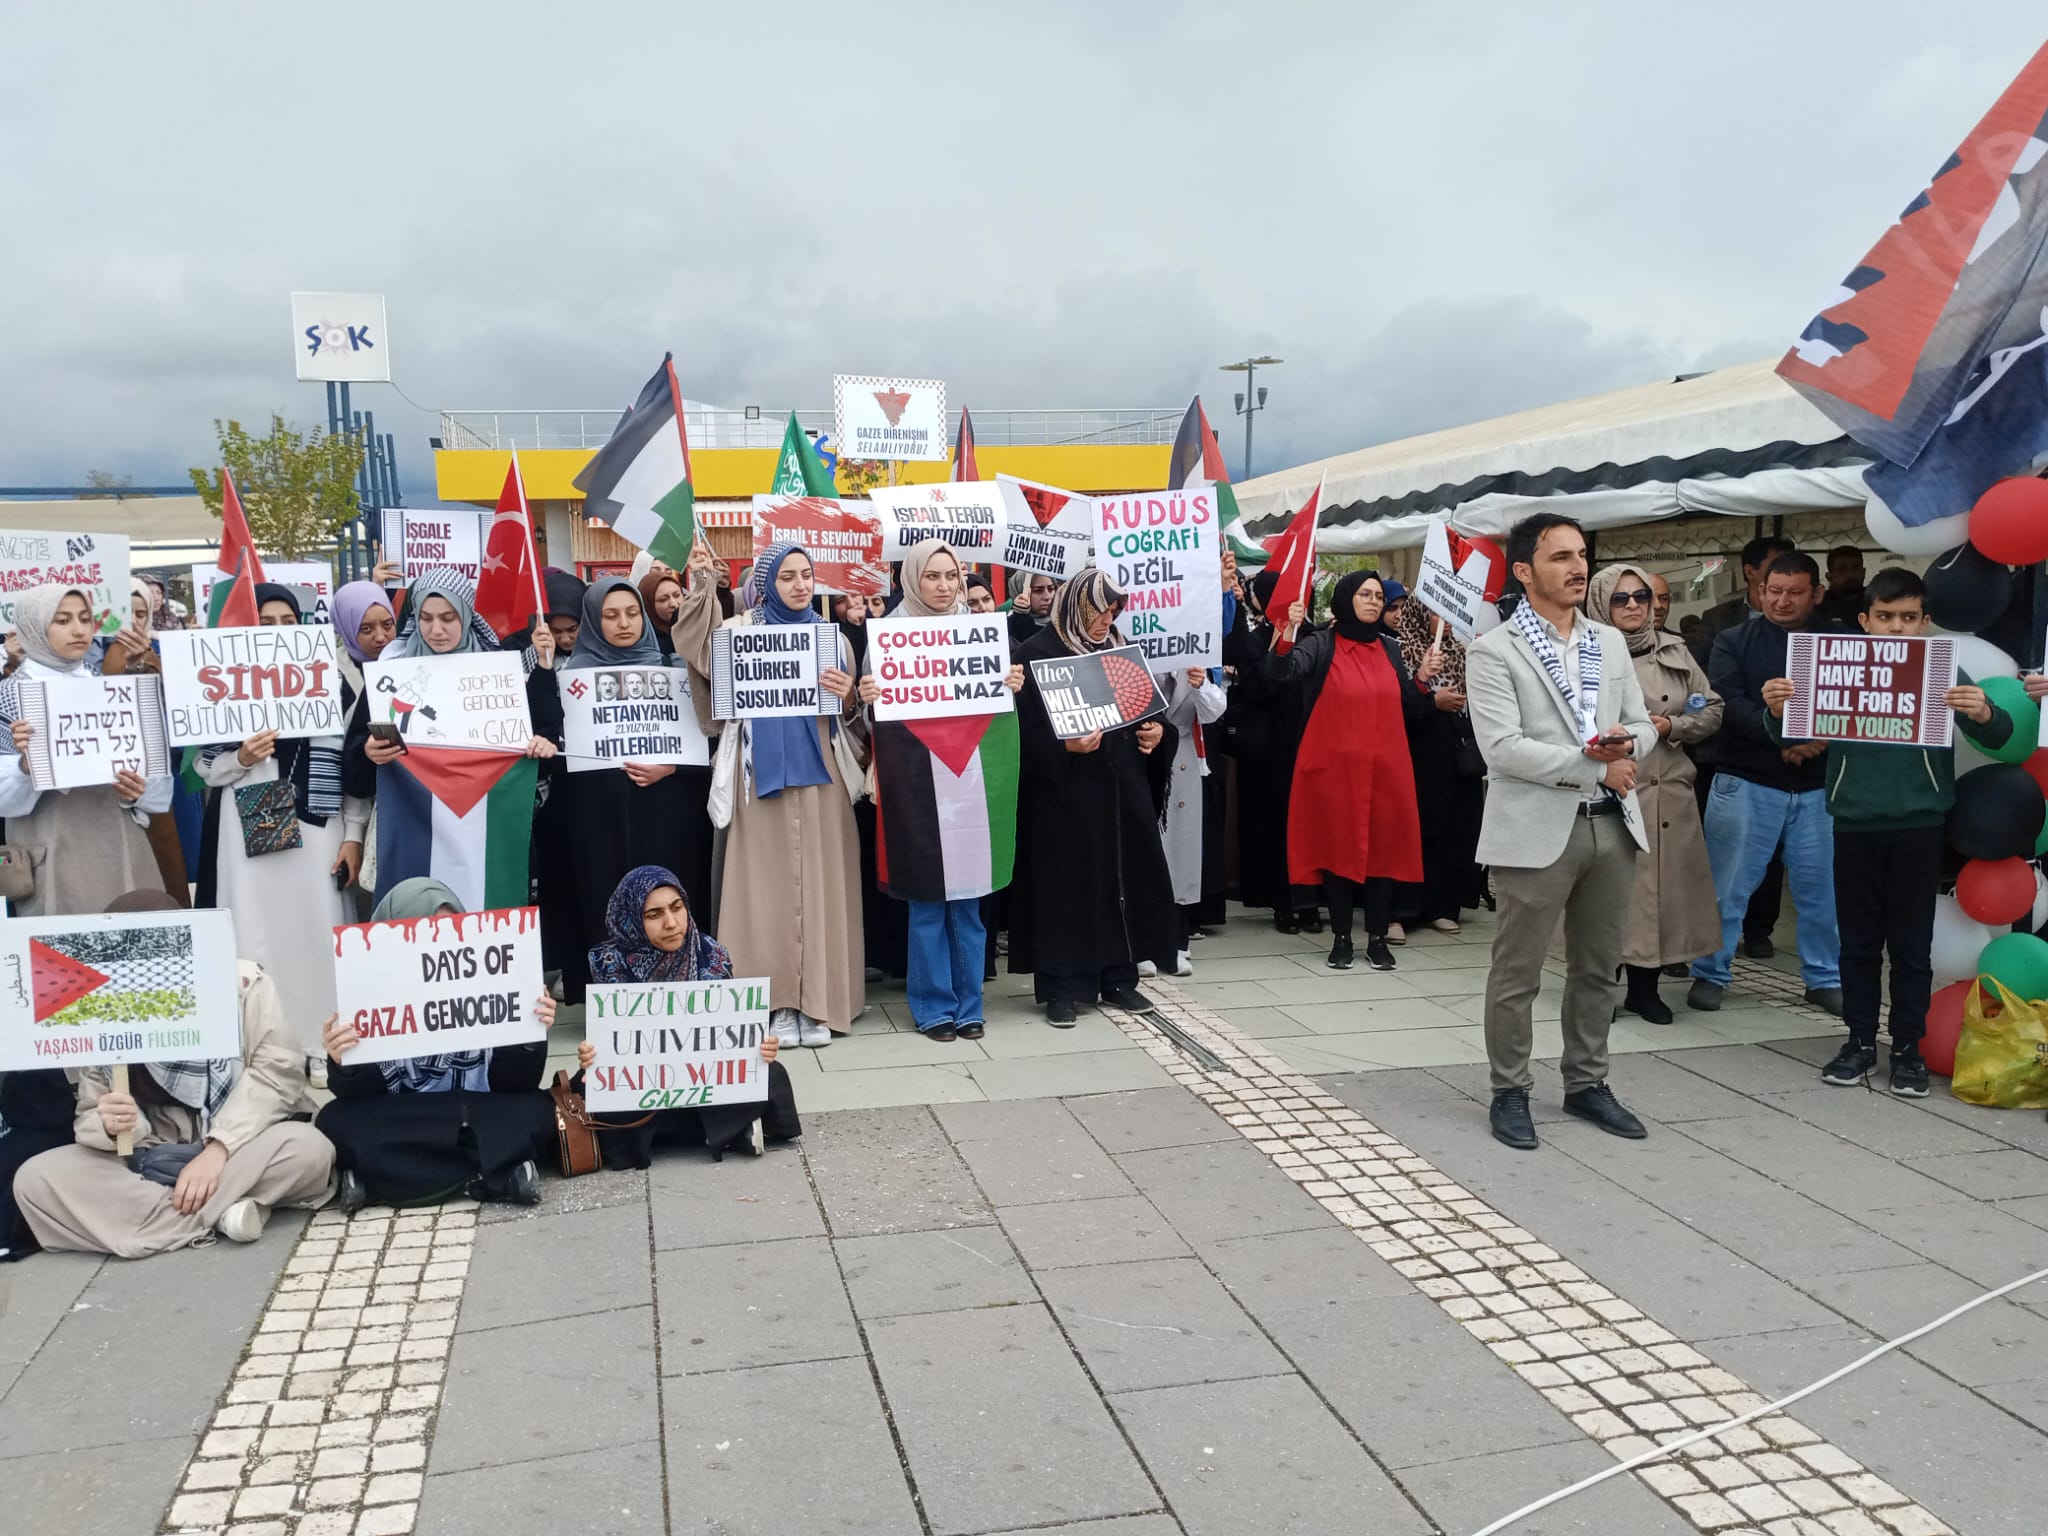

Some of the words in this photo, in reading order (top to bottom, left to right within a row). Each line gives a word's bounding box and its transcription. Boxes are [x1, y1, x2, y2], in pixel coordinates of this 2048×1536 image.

[305, 324, 374, 357] ŞOK
[857, 427, 881, 439] GAZZE
[884, 427, 928, 443] DİRENİŞİNİ
[857, 441, 928, 455] SELAMLIYORUZ
[893, 504, 944, 524] İSRAİL
[944, 504, 994, 524] TERÖR
[1102, 493, 1210, 531] KUDÜS
[406, 519, 451, 541] İŞGALE
[821, 529, 873, 547] SEVKİYAT
[1108, 527, 1200, 557] COĞRAFİ
[407, 543, 446, 561] KARŞI
[1008, 533, 1065, 560] LİMANLAR
[1003, 547, 1065, 575] KAPATILSIN
[1118, 557, 1184, 587] DEĞİL
[1132, 612, 1167, 636] BİR
[190, 630, 334, 666] İNTİFADA
[733, 632, 810, 658] ÇOCUKLAR
[877, 627, 999, 653] ÇOCUKLAR
[1819, 639, 1867, 662] LAND
[1872, 641, 1908, 664] YOU
[734, 658, 800, 681] ÖLÜRKEN
[880, 655, 1001, 680] ÖLÜRKEN
[1036, 664, 1075, 687] they
[1818, 664, 1865, 687] HAVE
[1870, 666, 1893, 688] TO
[104, 681, 132, 704] אל
[197, 660, 330, 704] ŞİMDİ
[458, 675, 490, 692] STOP
[491, 673, 515, 689] THE
[881, 681, 1005, 705] SUSULMAZ
[735, 688, 816, 709] SUSULMAZ
[1043, 686, 1090, 713] WILL
[1816, 689, 1853, 711] KILL
[1858, 690, 1893, 714] FOR
[1897, 693, 1916, 715] IS
[58, 710, 134, 738] תשתוק
[172, 702, 243, 738] BÜTÜN
[250, 700, 344, 733] DÜNYADA
[592, 704, 679, 724] NETANYAHU
[1050, 703, 1123, 735] RETURN
[1815, 714, 1850, 736] NOT
[1854, 715, 1913, 740] YOURS
[108, 730, 137, 753] על
[484, 718, 530, 745] GAZA
[55, 737, 100, 757] רצח
[595, 733, 682, 758] HİTLERİDİR!
[421, 946, 477, 983] DAYS
[484, 944, 514, 975] OF
[593, 984, 722, 1018] YÜZÜNCÜ
[729, 986, 768, 1012] YIL
[354, 1004, 418, 1039] GAZA
[34, 1037, 94, 1059] YAŞASIN
[98, 1031, 143, 1052] ÖZGÜR
[148, 1029, 201, 1048] FİLİSTİN
[612, 1022, 769, 1055] UNIVERSITY
[593, 1063, 676, 1092] STAND
[686, 1057, 758, 1086] WITH
[639, 1086, 713, 1109] GAZZE
